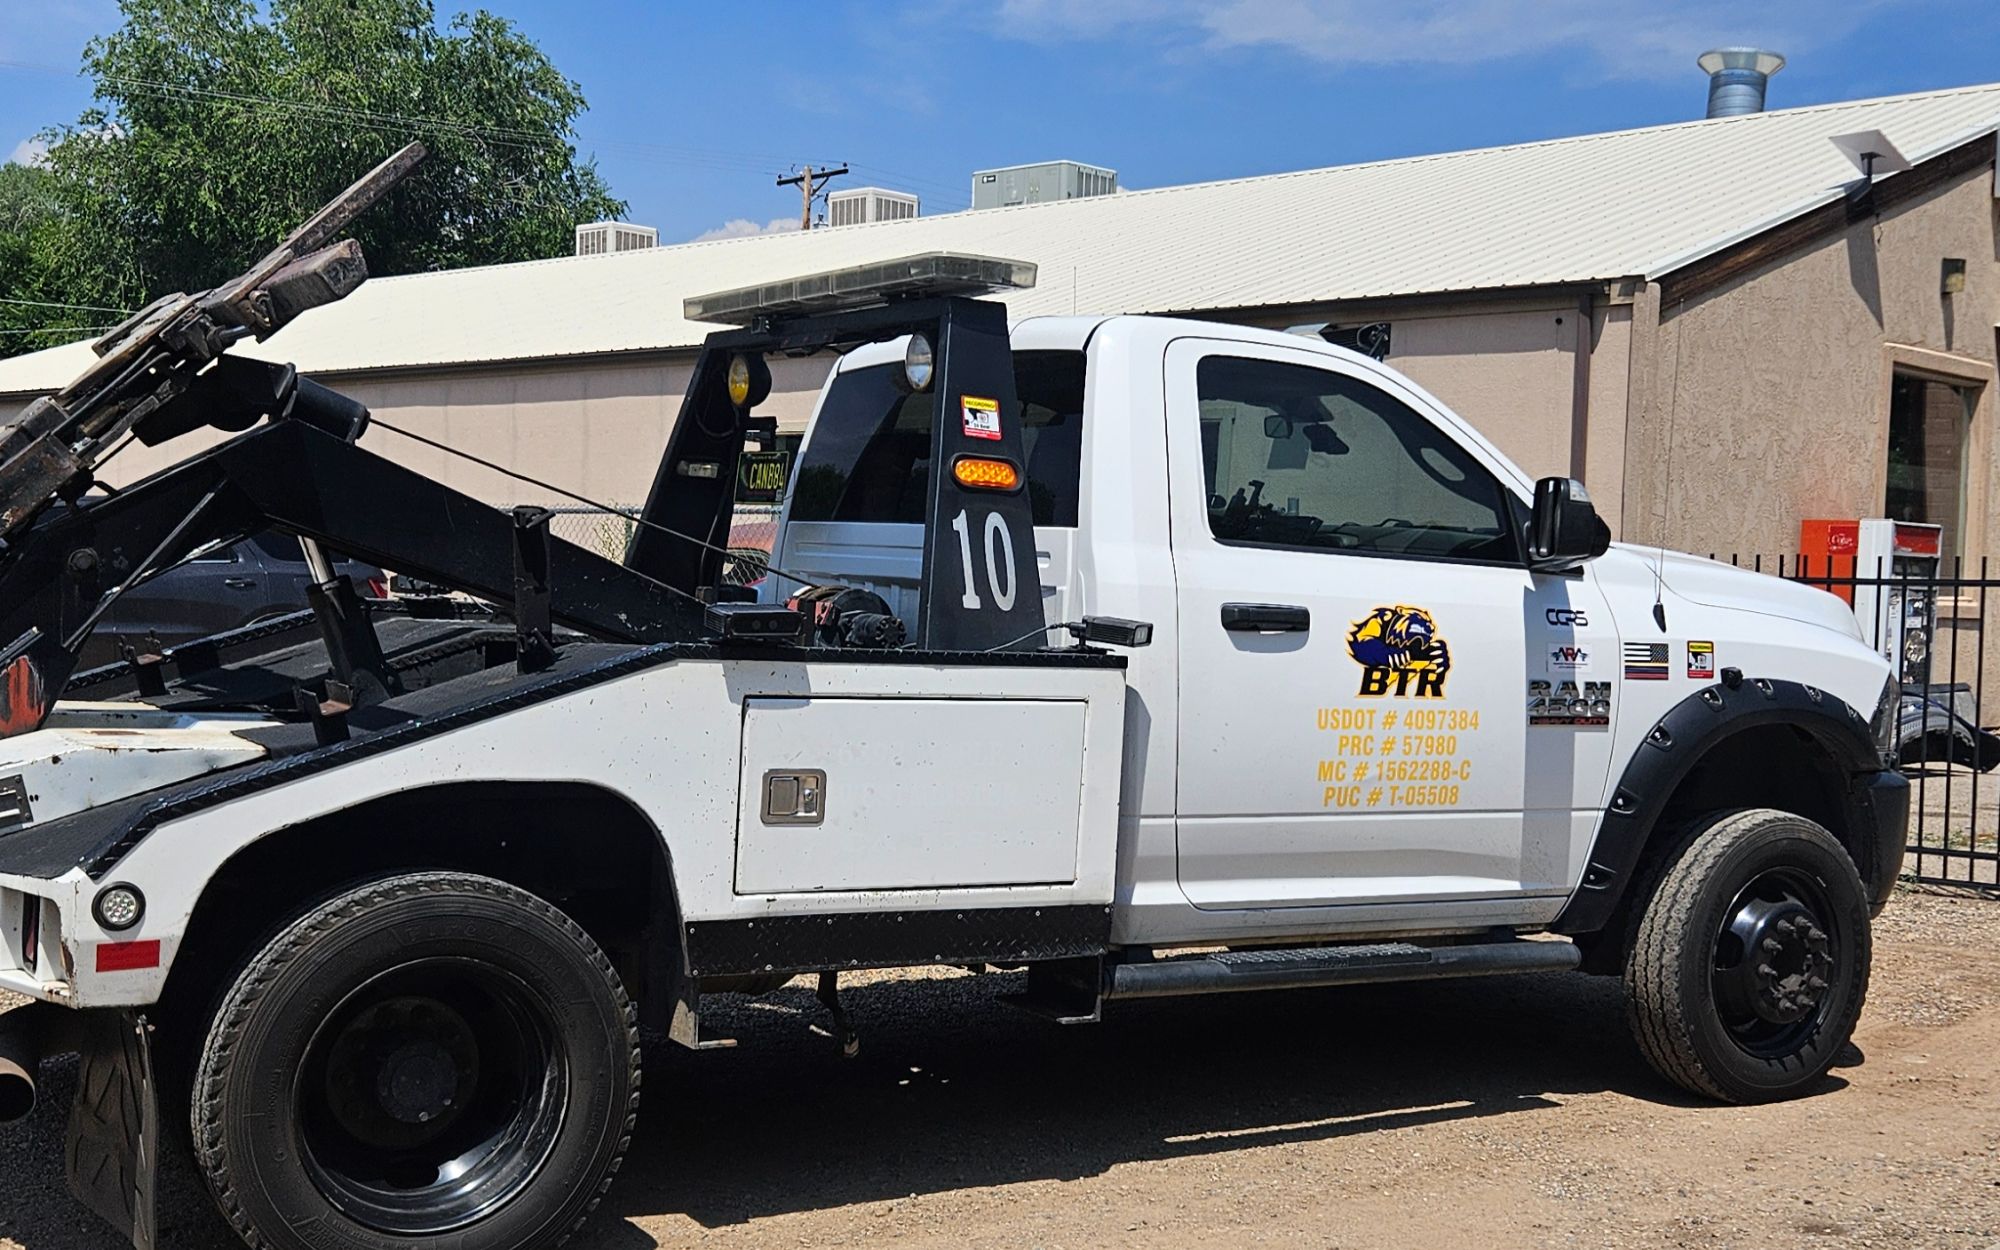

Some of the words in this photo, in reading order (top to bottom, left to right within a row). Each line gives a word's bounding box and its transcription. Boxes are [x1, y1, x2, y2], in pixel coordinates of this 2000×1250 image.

[952, 509, 1017, 611] 10
[1358, 666, 1448, 697] BTR
[1529, 680, 1612, 698] RAM
[1527, 698, 1611, 716] 4500
[1317, 708, 1376, 730] USDOT
[1382, 710, 1398, 730] #
[1403, 709, 1480, 730] 4097384
[1338, 735, 1374, 756] PRC
[1380, 735, 1397, 756] #
[1402, 735, 1457, 756] 57980
[1318, 760, 1346, 782] MC
[1353, 761, 1369, 781] #
[1377, 759, 1471, 781] 1562288-C
[1323, 785, 1360, 807] PUC
[1367, 786, 1383, 806] #
[1390, 784, 1459, 806] T-05508
